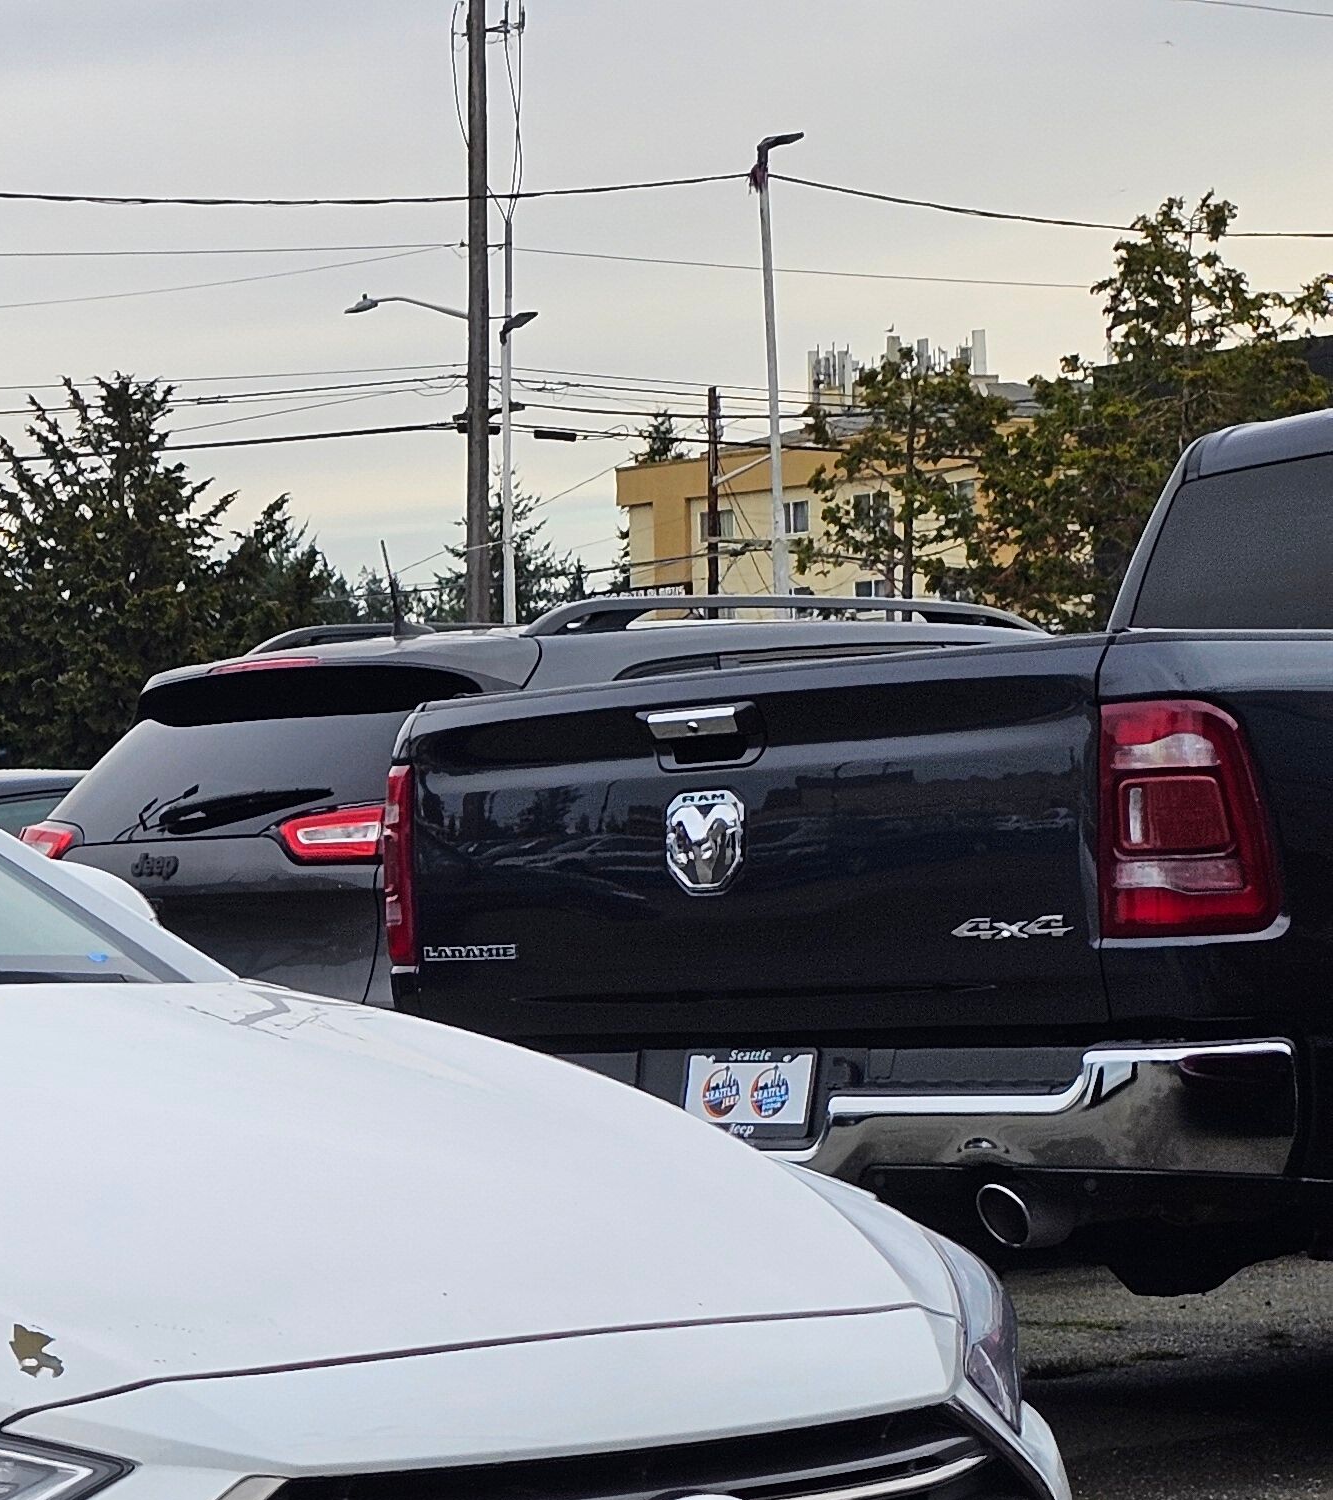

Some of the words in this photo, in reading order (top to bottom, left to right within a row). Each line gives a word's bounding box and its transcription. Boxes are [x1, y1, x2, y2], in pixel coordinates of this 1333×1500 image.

[681, 793, 726, 803] RAM
[130, 852, 180, 881] Jeep
[951, 914, 1075, 940] 4x4
[423, 944, 517, 961] LARAMIE
[729, 1049, 772, 1061] Seattle
[704, 1084, 737, 1100] SEATTLE
[752, 1084, 786, 1100] SEATTLE
